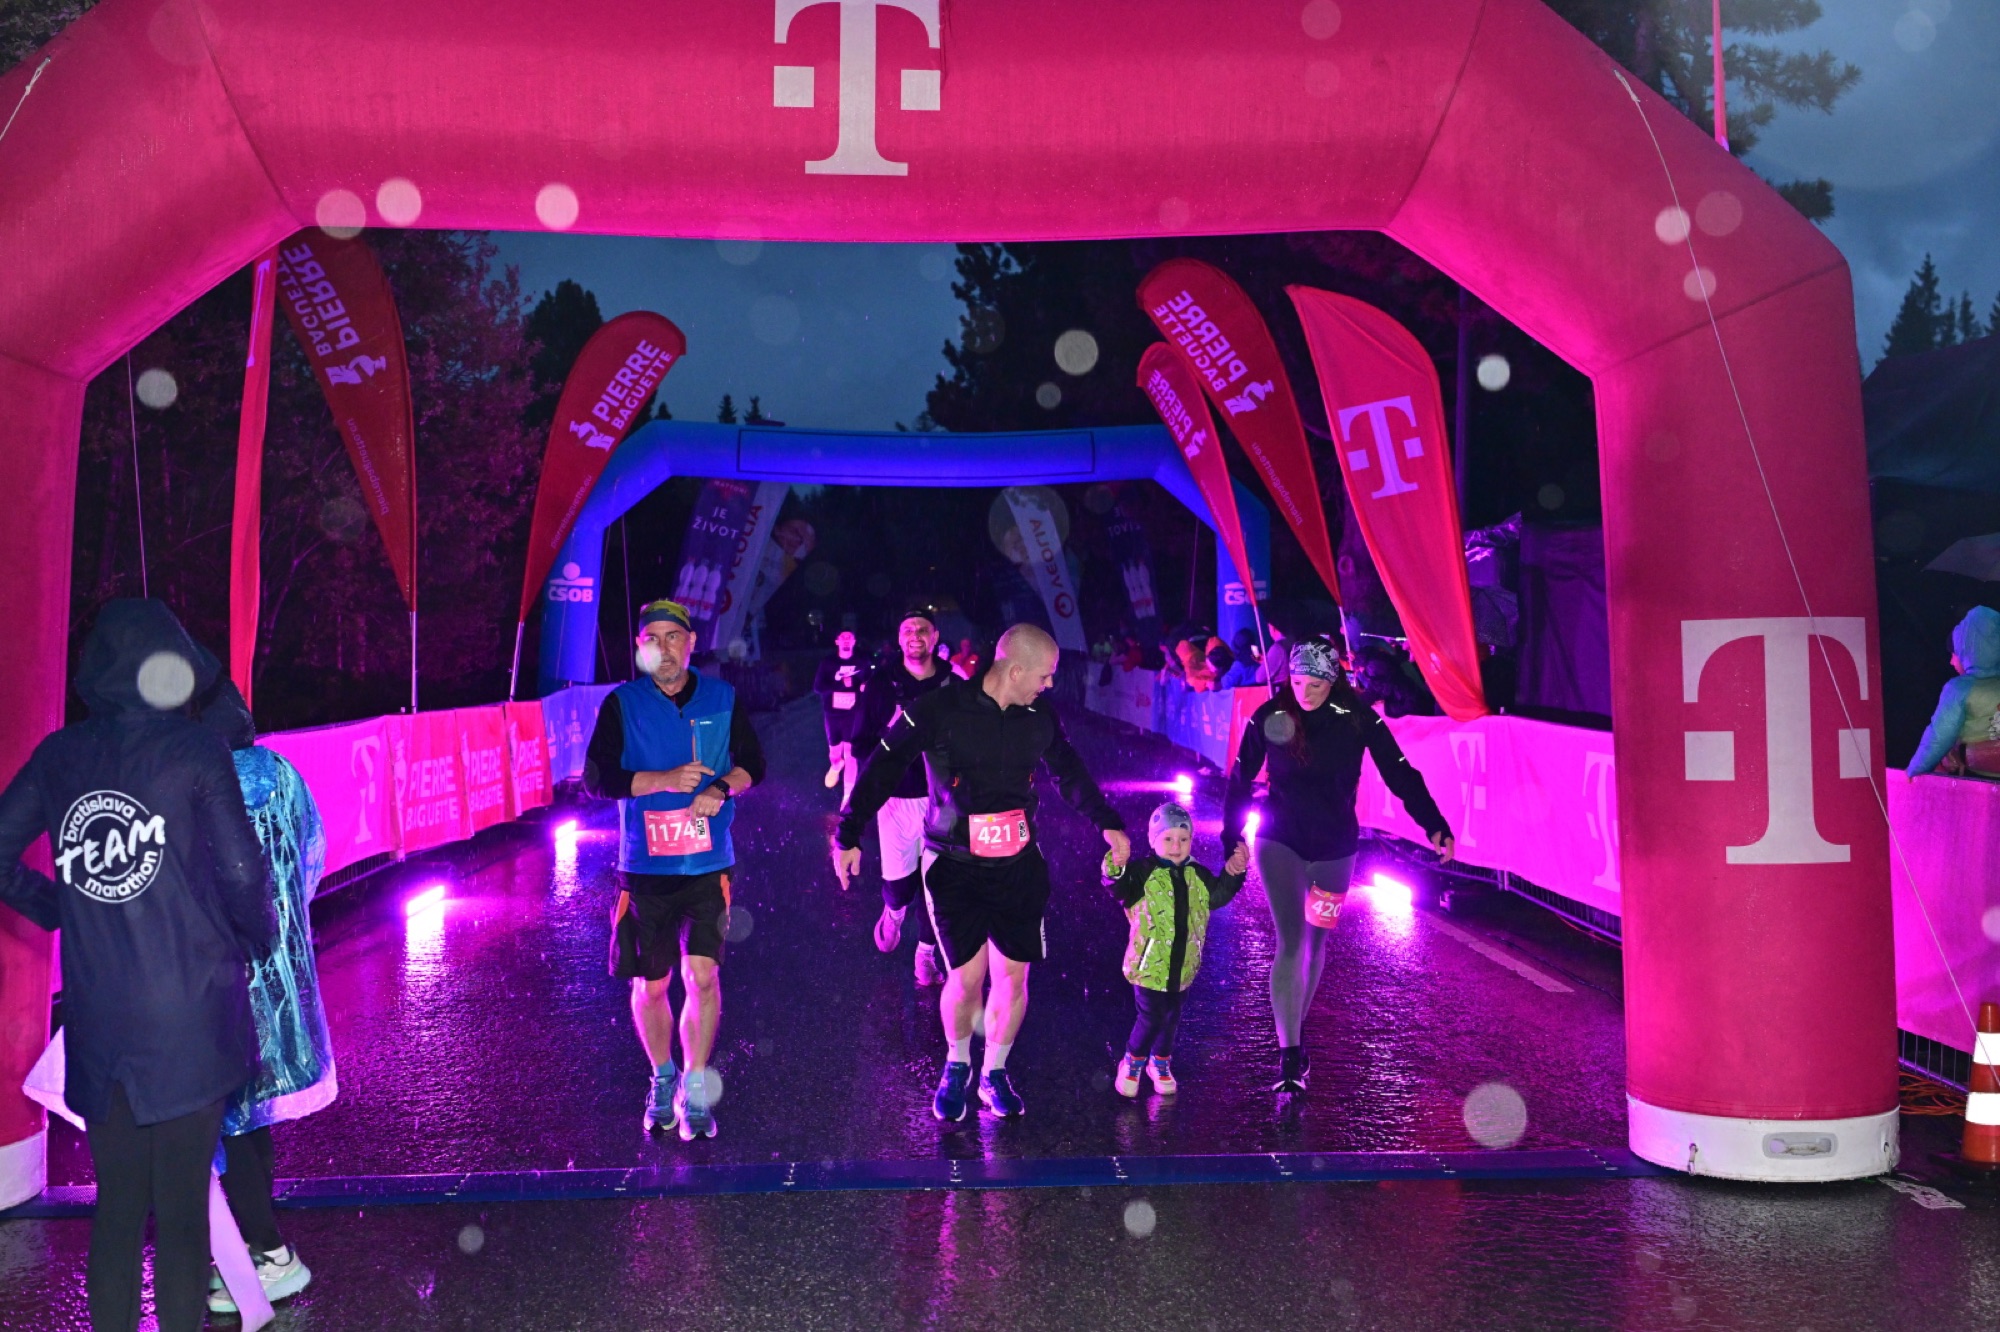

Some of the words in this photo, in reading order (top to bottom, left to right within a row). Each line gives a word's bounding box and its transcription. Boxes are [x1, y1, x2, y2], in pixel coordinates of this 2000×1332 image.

[591, 339, 660, 422] PIERRE
[611, 350, 673, 430] BAGUETTE
[1338, 395, 1424, 499] T
[692, 516, 739, 540] ŽIVOT
[712, 506, 728, 519] JE
[1681, 617, 1871, 865] T
[64, 795, 136, 843] bratislava
[649, 820, 695, 842] 1174
[977, 824, 1011, 844] 421
[55, 815, 166, 885] TEAM
[85, 851, 158, 897] marathon
